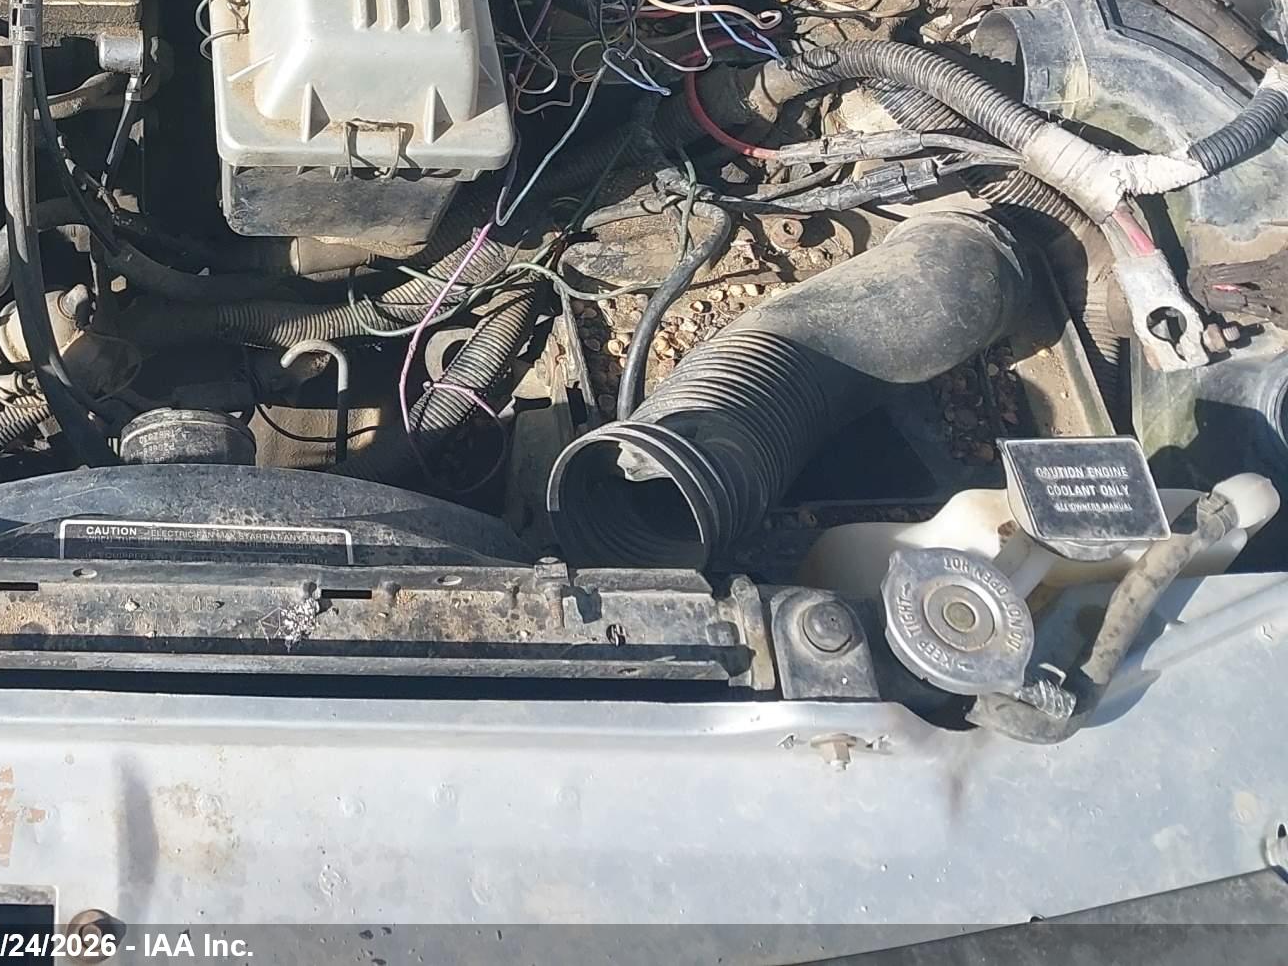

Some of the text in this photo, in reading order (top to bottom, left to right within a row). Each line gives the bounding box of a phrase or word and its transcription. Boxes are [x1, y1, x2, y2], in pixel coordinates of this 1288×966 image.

[1035, 466, 1129, 479] CAUTION ENGINE
[1046, 485, 1130, 496] COOLANT ONLY
[86, 526, 137, 536] CAUTION
[943, 557, 970, 573] HOT
[973, 568, 1009, 598] OPEN
[1002, 600, 1025, 630] NOT
[896, 596, 950, 670] KEEP TIGHT
